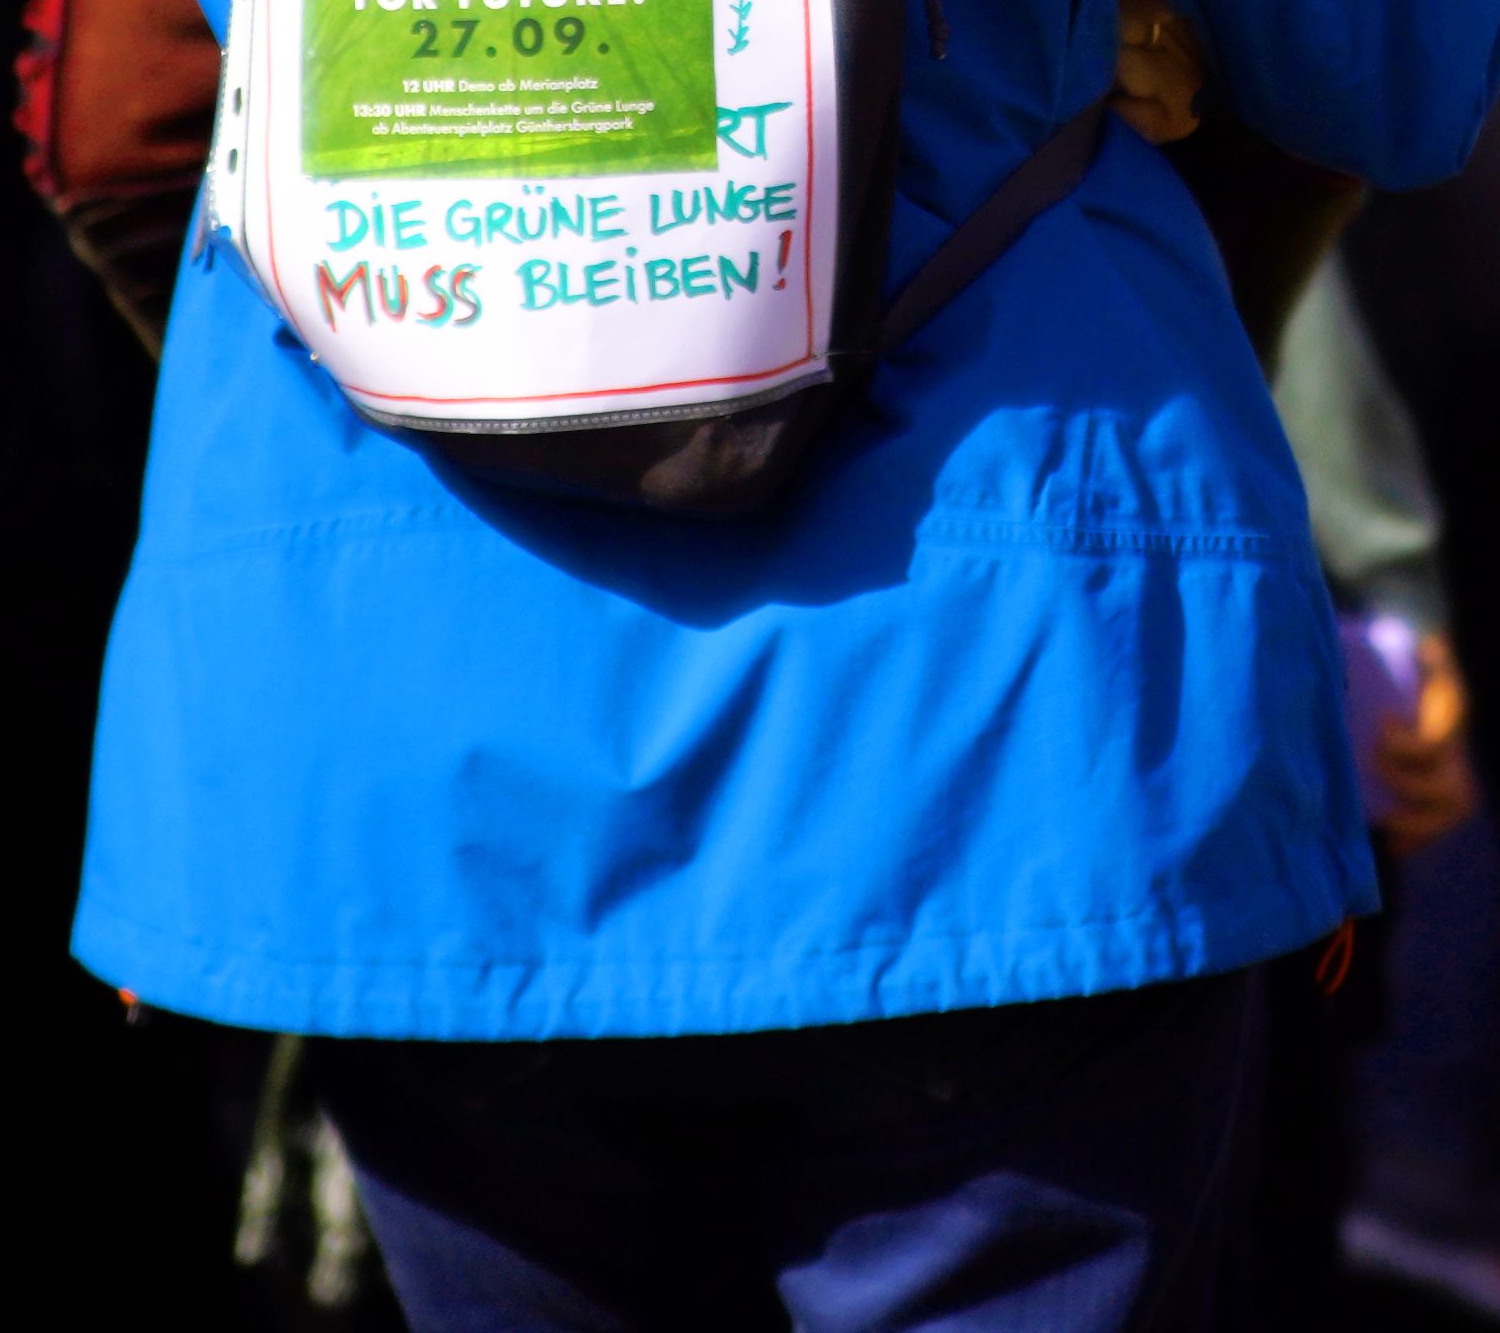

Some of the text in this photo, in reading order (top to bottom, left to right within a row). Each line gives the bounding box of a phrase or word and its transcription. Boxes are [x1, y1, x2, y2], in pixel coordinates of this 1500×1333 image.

[410, 16, 610, 59] 27.09.
[403, 76, 598, 93] 12 UHR Demo ab Merianplatz
[353, 99, 655, 117] 13:30 UHR Menschenkette um die Grüne Lunge
[372, 116, 634, 137] ab Abenteuerspielplatz Günthersburgpark
[716, 101, 794, 161] RT
[445, 184, 629, 245] GRÜNE
[650, 180, 797, 235] LUNGE
[315, 259, 484, 333] MUSS
